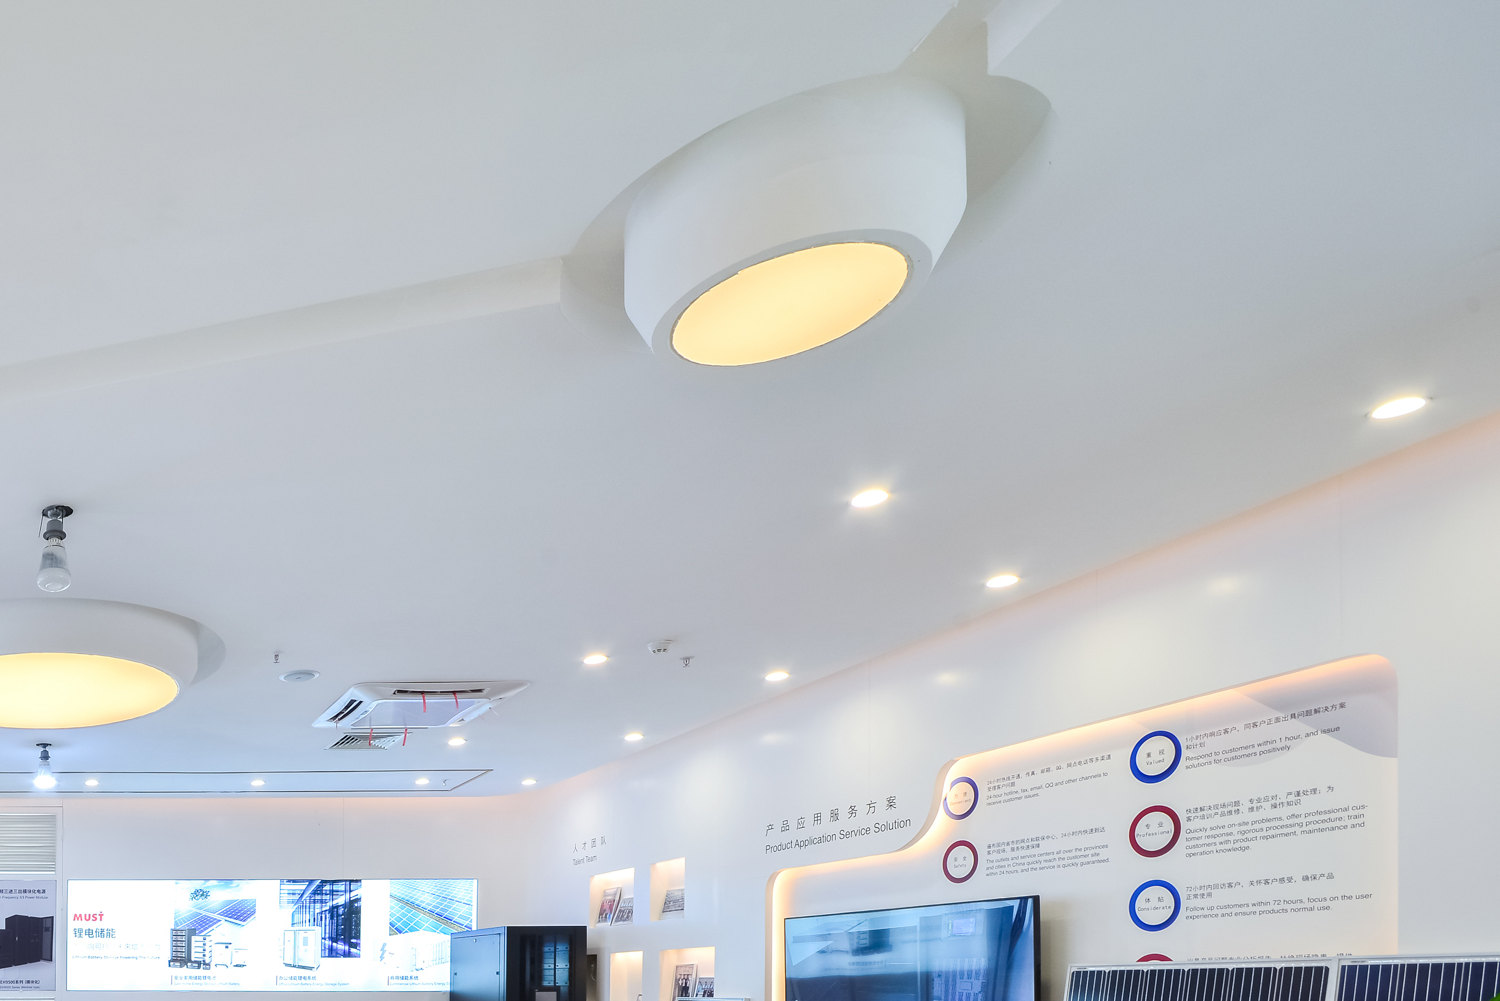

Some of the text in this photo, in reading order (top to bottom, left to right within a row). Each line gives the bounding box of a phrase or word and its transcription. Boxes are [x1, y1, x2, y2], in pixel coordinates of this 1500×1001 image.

[1186, 726, 1340, 762] Respond customers within and issue
[1146, 758, 1165, 766] Valued
[1185, 752, 1257, 770] solutions customers
[765, 796, 897, 836] 产品应用服务方案
[1186, 826, 1208, 834] Quickly
[1305, 806, 1349, 818] professional
[765, 817, 911, 854] Product Application Service Solution
[573, 855, 597, 866] Talent Team
[1216, 902, 1250, 910] customers
[73, 912, 104, 921] MUST
[73, 928, 116, 938] 锂电储能
